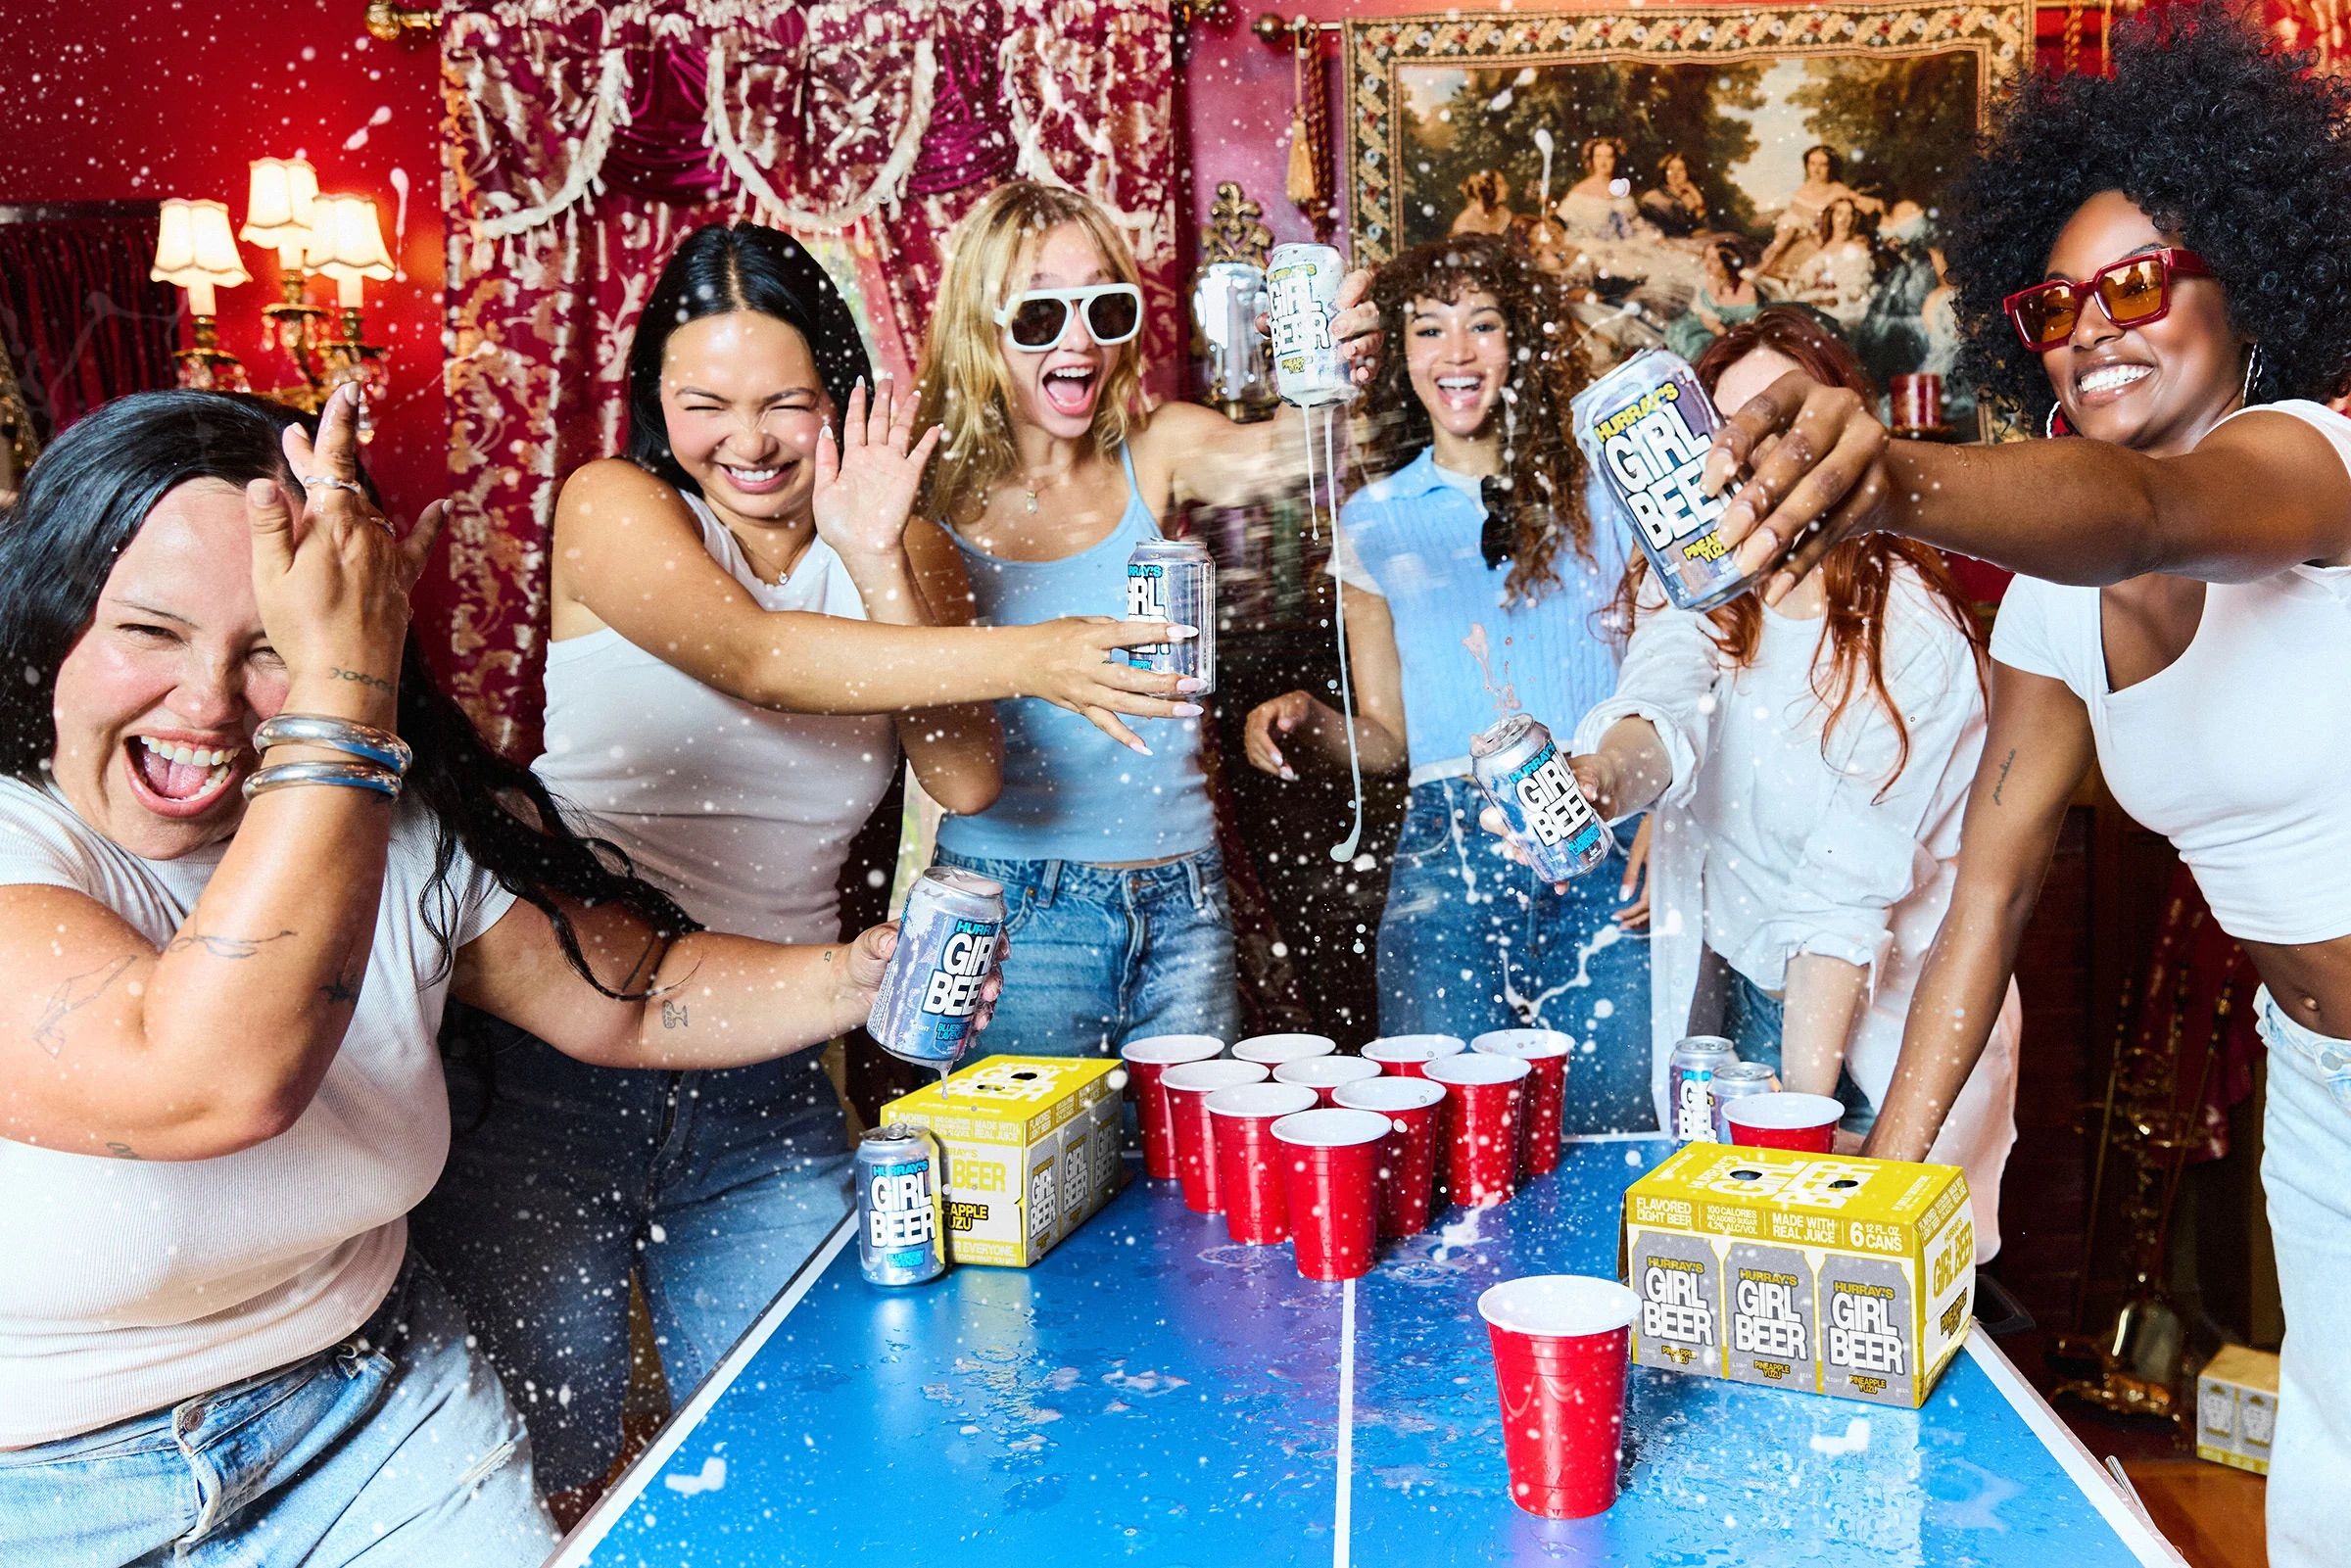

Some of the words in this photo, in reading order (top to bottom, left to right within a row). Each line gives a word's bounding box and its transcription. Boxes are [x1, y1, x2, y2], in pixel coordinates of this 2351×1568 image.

[1605, 403, 1712, 493] GIRL
[1627, 457, 1743, 550] BEE
[1517, 752, 1574, 813] GIRL
[1528, 786, 1594, 847] BEE
[944, 933, 994, 976] GIR
[923, 970, 983, 1016] BEE
[873, 1161, 929, 1176] HURRAY'S
[952, 1159, 1006, 1192] BEER
[1066, 1144, 1087, 1182] GIRL
[871, 1171, 933, 1212] GIRL
[1032, 1166, 1055, 1206] GIRL
[1064, 1169, 1088, 1213] BEER
[948, 1215, 972, 1230] UZU
[1030, 1193, 1057, 1238] BEER
[1636, 1197, 1692, 1215] FLAVORED
[1637, 1210, 1664, 1224] LIGHT
[1667, 1212, 1692, 1227] BEER
[1720, 1206, 1757, 1219] CALORIES
[1772, 1212, 1804, 1227] MADE
[1806, 1216, 1835, 1231] WITH
[869, 1205, 936, 1248] BEER
[1772, 1225, 1801, 1240] REAL
[1803, 1229, 1835, 1244] JUICE
[1849, 1221, 1865, 1248] 6
[1865, 1223, 1874, 1233] 12
[1865, 1233, 1902, 1253] CANS
[1647, 1257, 1704, 1273] HURRAY'S
[1739, 1268, 1798, 1286] HURRAY'S
[1933, 1245, 1953, 1299] GIRL
[1645, 1266, 1707, 1309] GIRL
[1737, 1279, 1801, 1322] GIRL
[1834, 1281, 1895, 1300] HURRAY'S
[1643, 1300, 1714, 1346] BEER
[1831, 1292, 1898, 1336] GIRL
[1734, 1313, 1808, 1360] BEER
[1828, 1326, 1905, 1375] BEER
[1753, 1360, 1791, 1374] PINEAPPLE
[1763, 1368, 1782, 1379] YUZU
[1849, 1375, 1887, 1389] PINEAPPLE
[1859, 1383, 1879, 1395] YUZU
